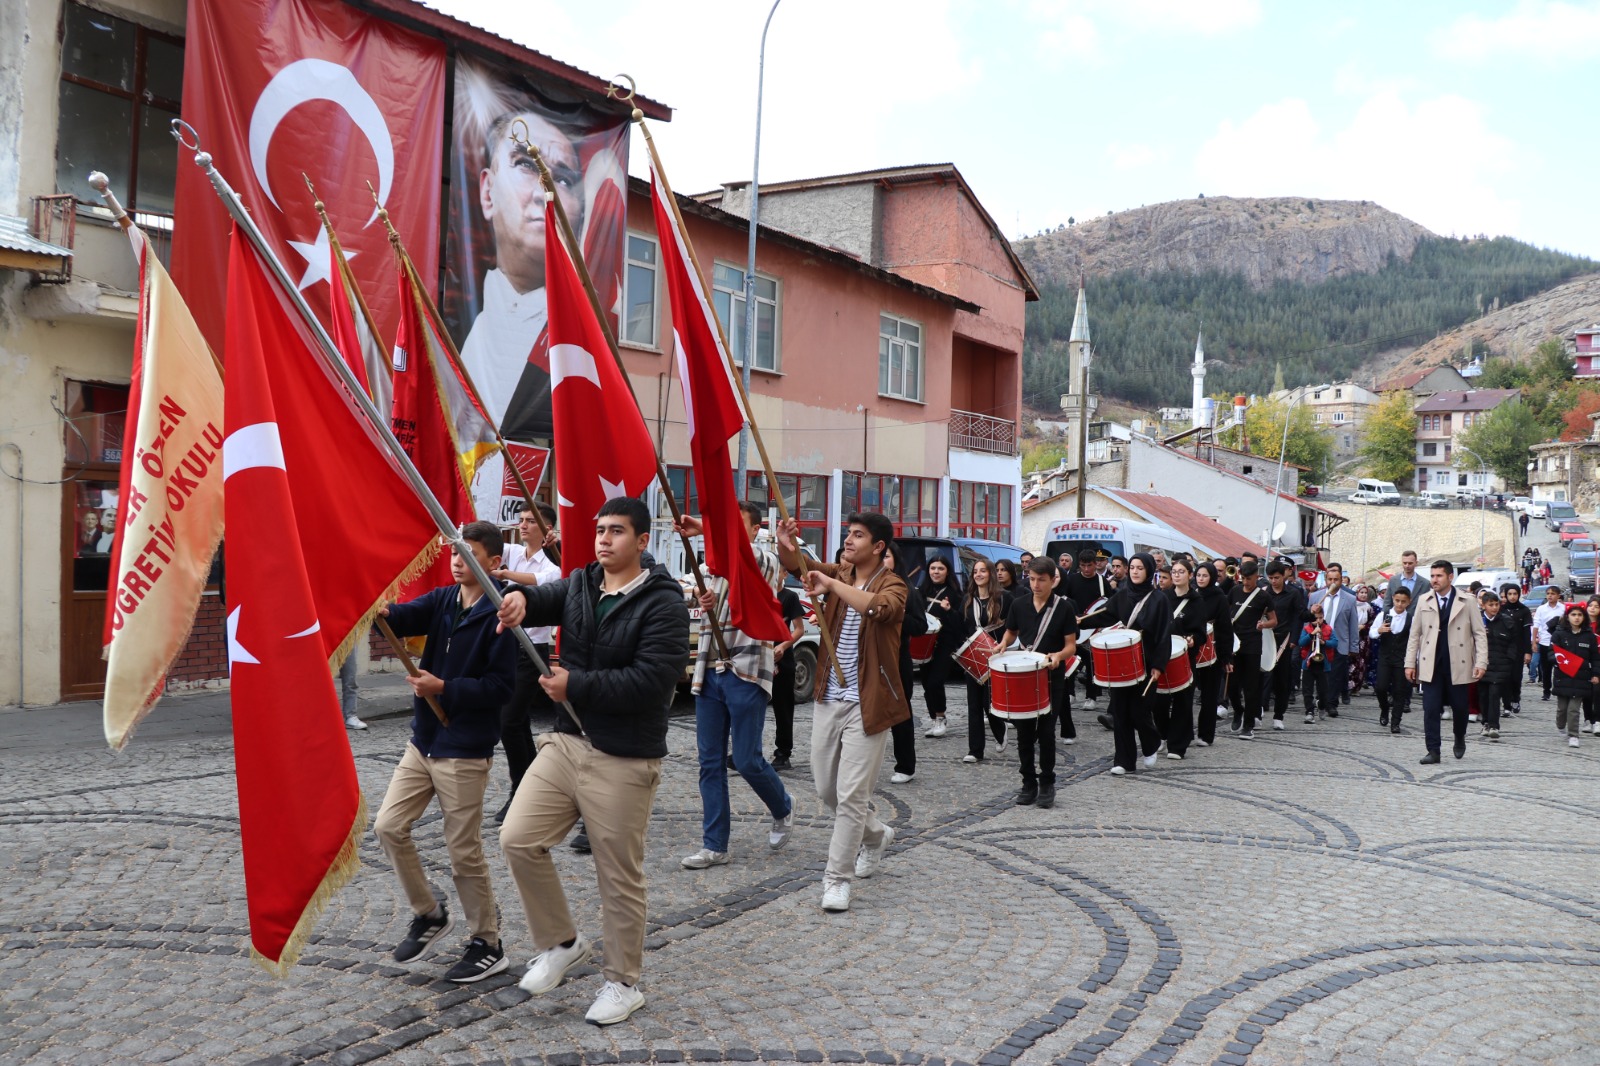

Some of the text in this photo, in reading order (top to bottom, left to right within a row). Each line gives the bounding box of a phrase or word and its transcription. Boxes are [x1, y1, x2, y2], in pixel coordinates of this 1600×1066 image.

[136, 394, 187, 479] ÖZEN
[166, 421, 225, 512] OKULU
[1052, 522, 1119, 534] TAŞKENT
